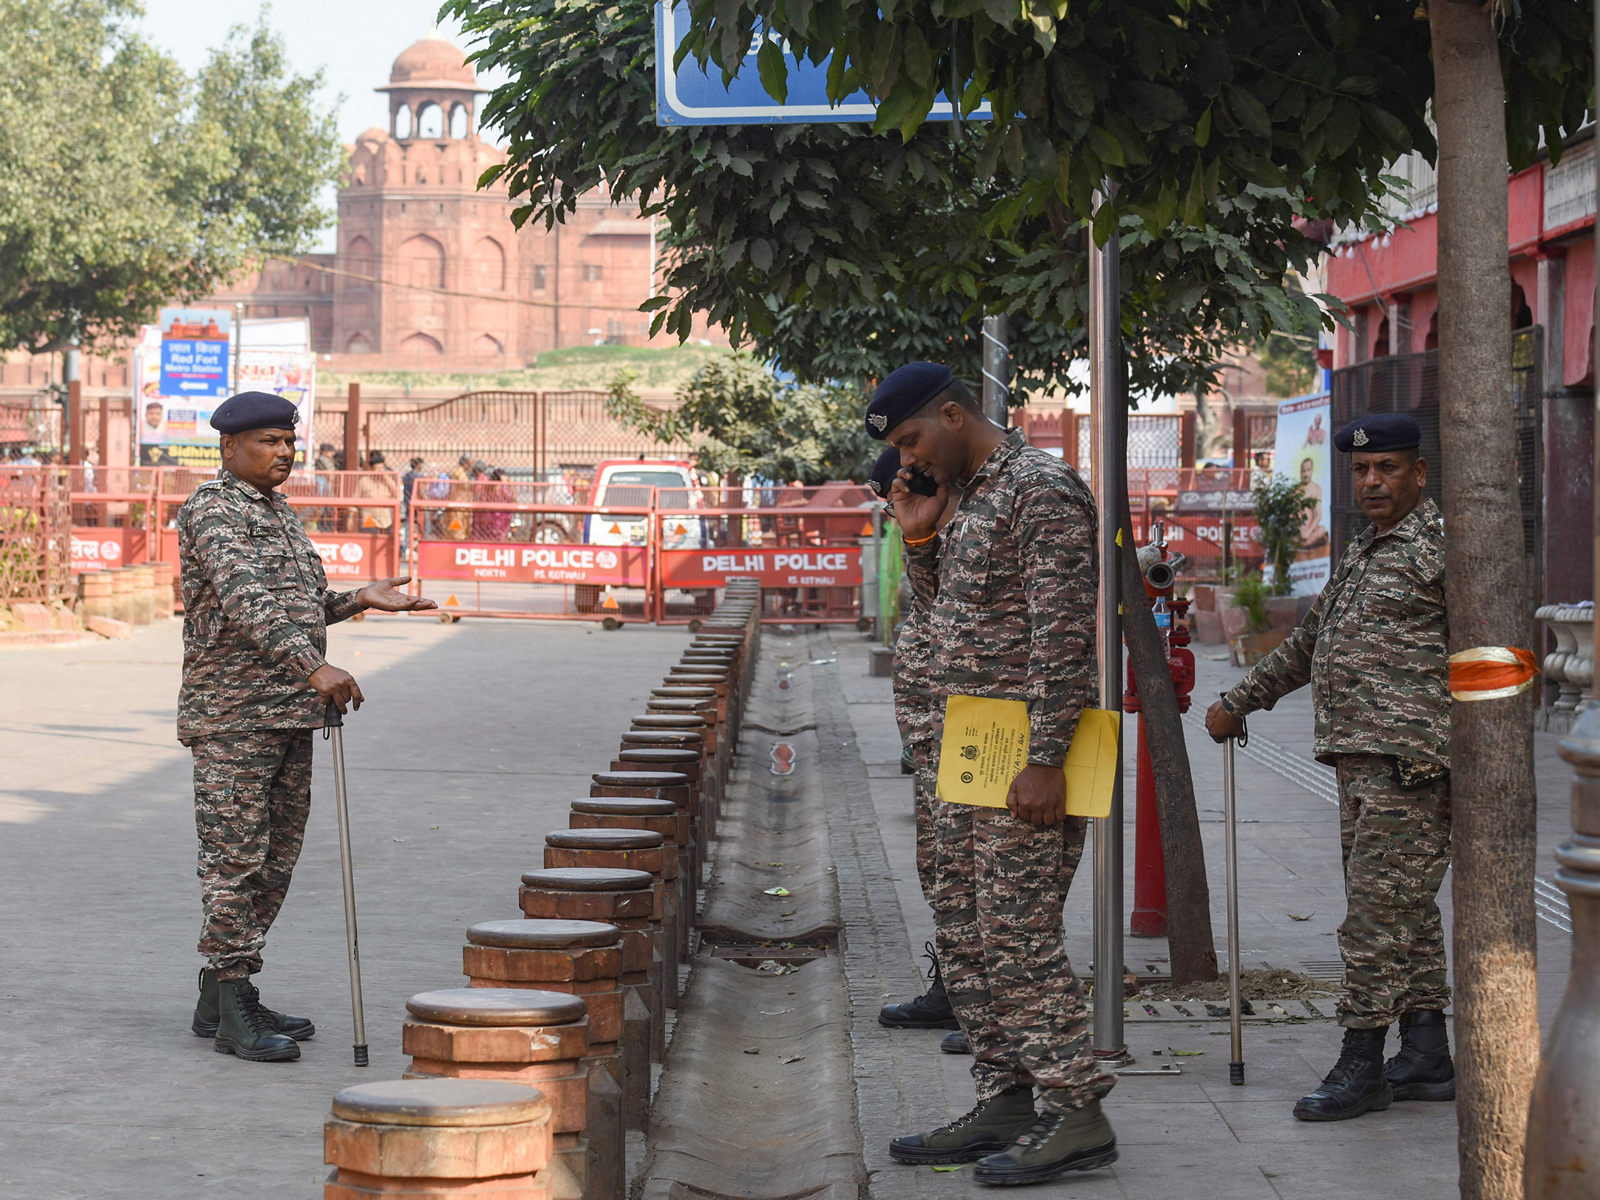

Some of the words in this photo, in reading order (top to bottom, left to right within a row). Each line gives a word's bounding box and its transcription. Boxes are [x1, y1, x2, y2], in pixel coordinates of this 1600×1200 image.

[169, 343, 191, 354] लाल
[195, 341, 221, 354] किला
[171, 353, 193, 364] Red
[195, 354, 218, 365] Fort
[165, 363, 191, 373] Metro
[192, 364, 223, 373] Station
[455, 548, 515, 566] DELHI
[522, 549, 594, 568] POLICE
[702, 554, 765, 572] DELHI
[774, 553, 847, 571] POLICE
[475, 568, 507, 578] NORTH
[548, 570, 586, 581] KOTWALI
[800, 575, 835, 586] KOTWALI
